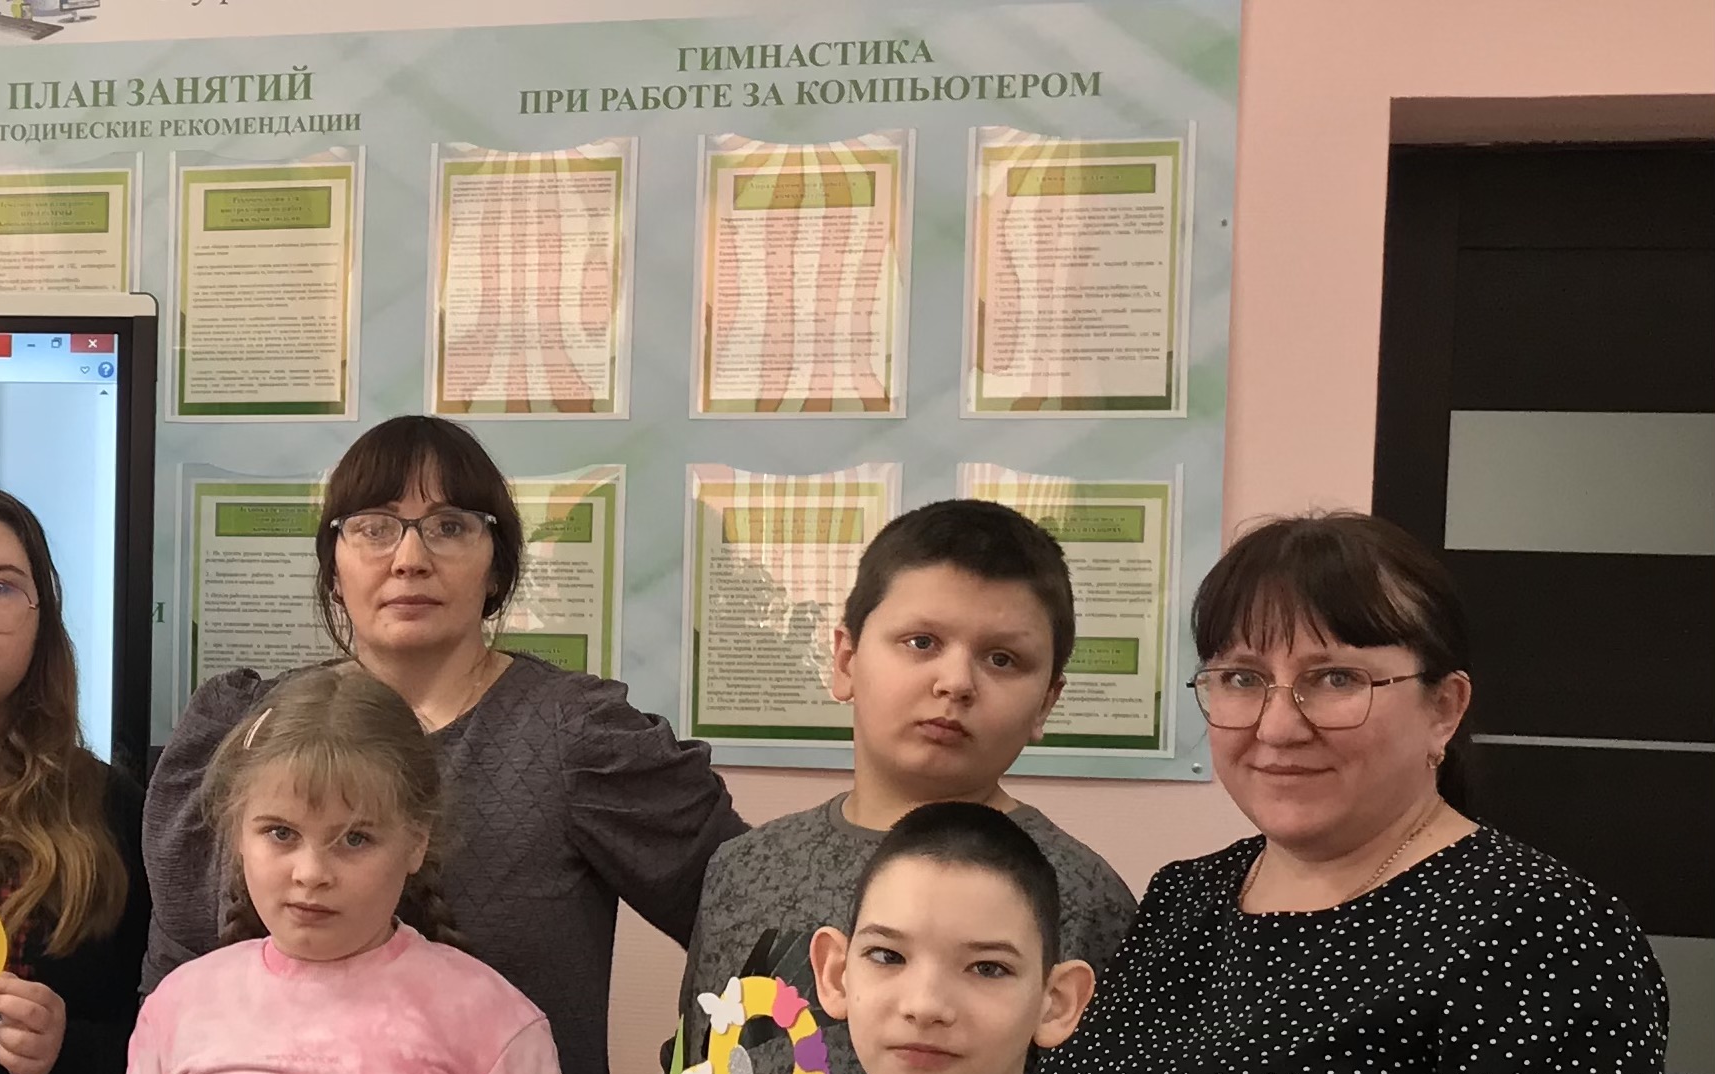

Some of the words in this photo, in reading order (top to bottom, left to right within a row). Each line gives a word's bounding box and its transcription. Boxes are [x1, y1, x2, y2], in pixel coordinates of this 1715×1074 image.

[676, 39, 934, 73] ГИМНАСТИКА
[7, 79, 117, 110] ПЛАН
[126, 65, 316, 107] ЗАНЯТИЙ
[518, 88, 590, 115] ПРИ
[599, 83, 732, 112] РАБОТЕ
[741, 82, 785, 108] ЗА
[794, 71, 1103, 107] КОМПЬЮТЕРОМ
[159, 113, 362, 138] РЕКОМЕНДАЦИИ
